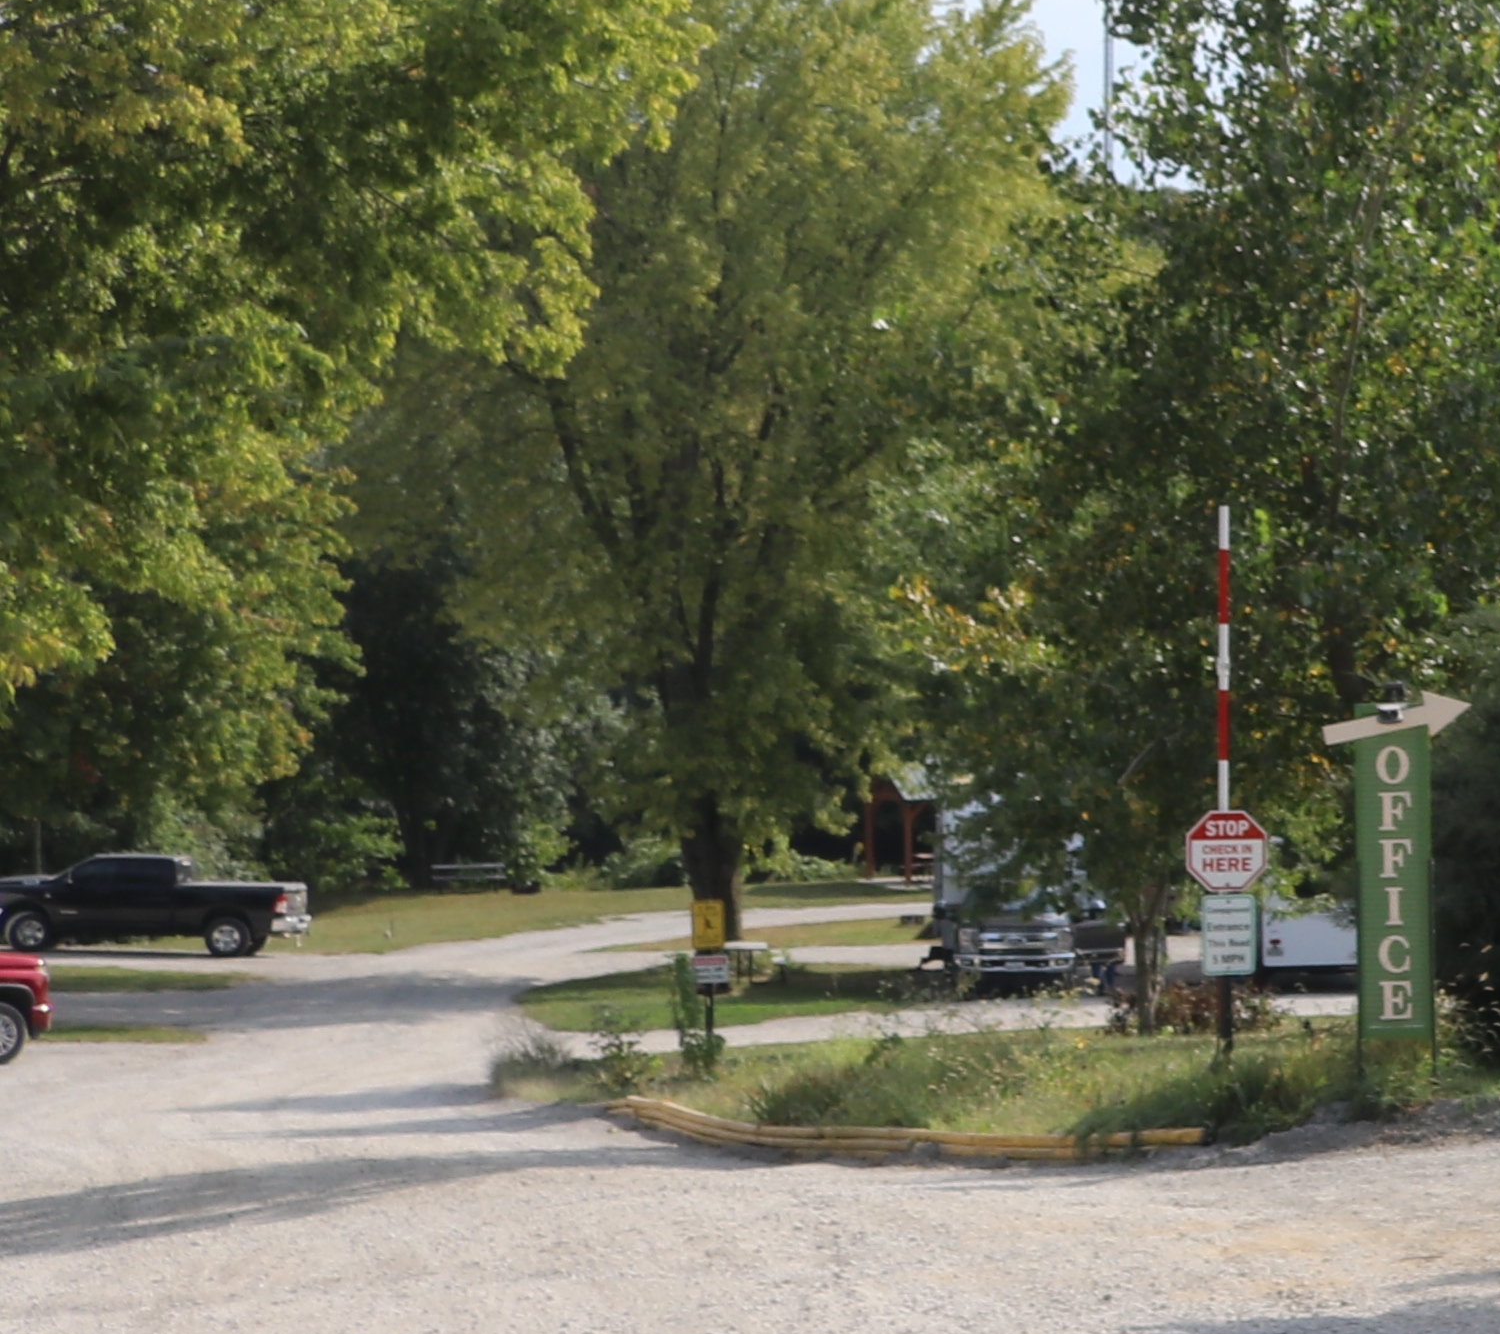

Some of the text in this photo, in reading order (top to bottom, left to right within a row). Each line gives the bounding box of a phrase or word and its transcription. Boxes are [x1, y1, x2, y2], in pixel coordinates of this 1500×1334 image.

[1204, 819, 1250, 837] STOP
[1202, 844, 1253, 855] CHECK IN
[1202, 857, 1253, 872] HERE
[1375, 746, 1413, 1021] OFFICE
